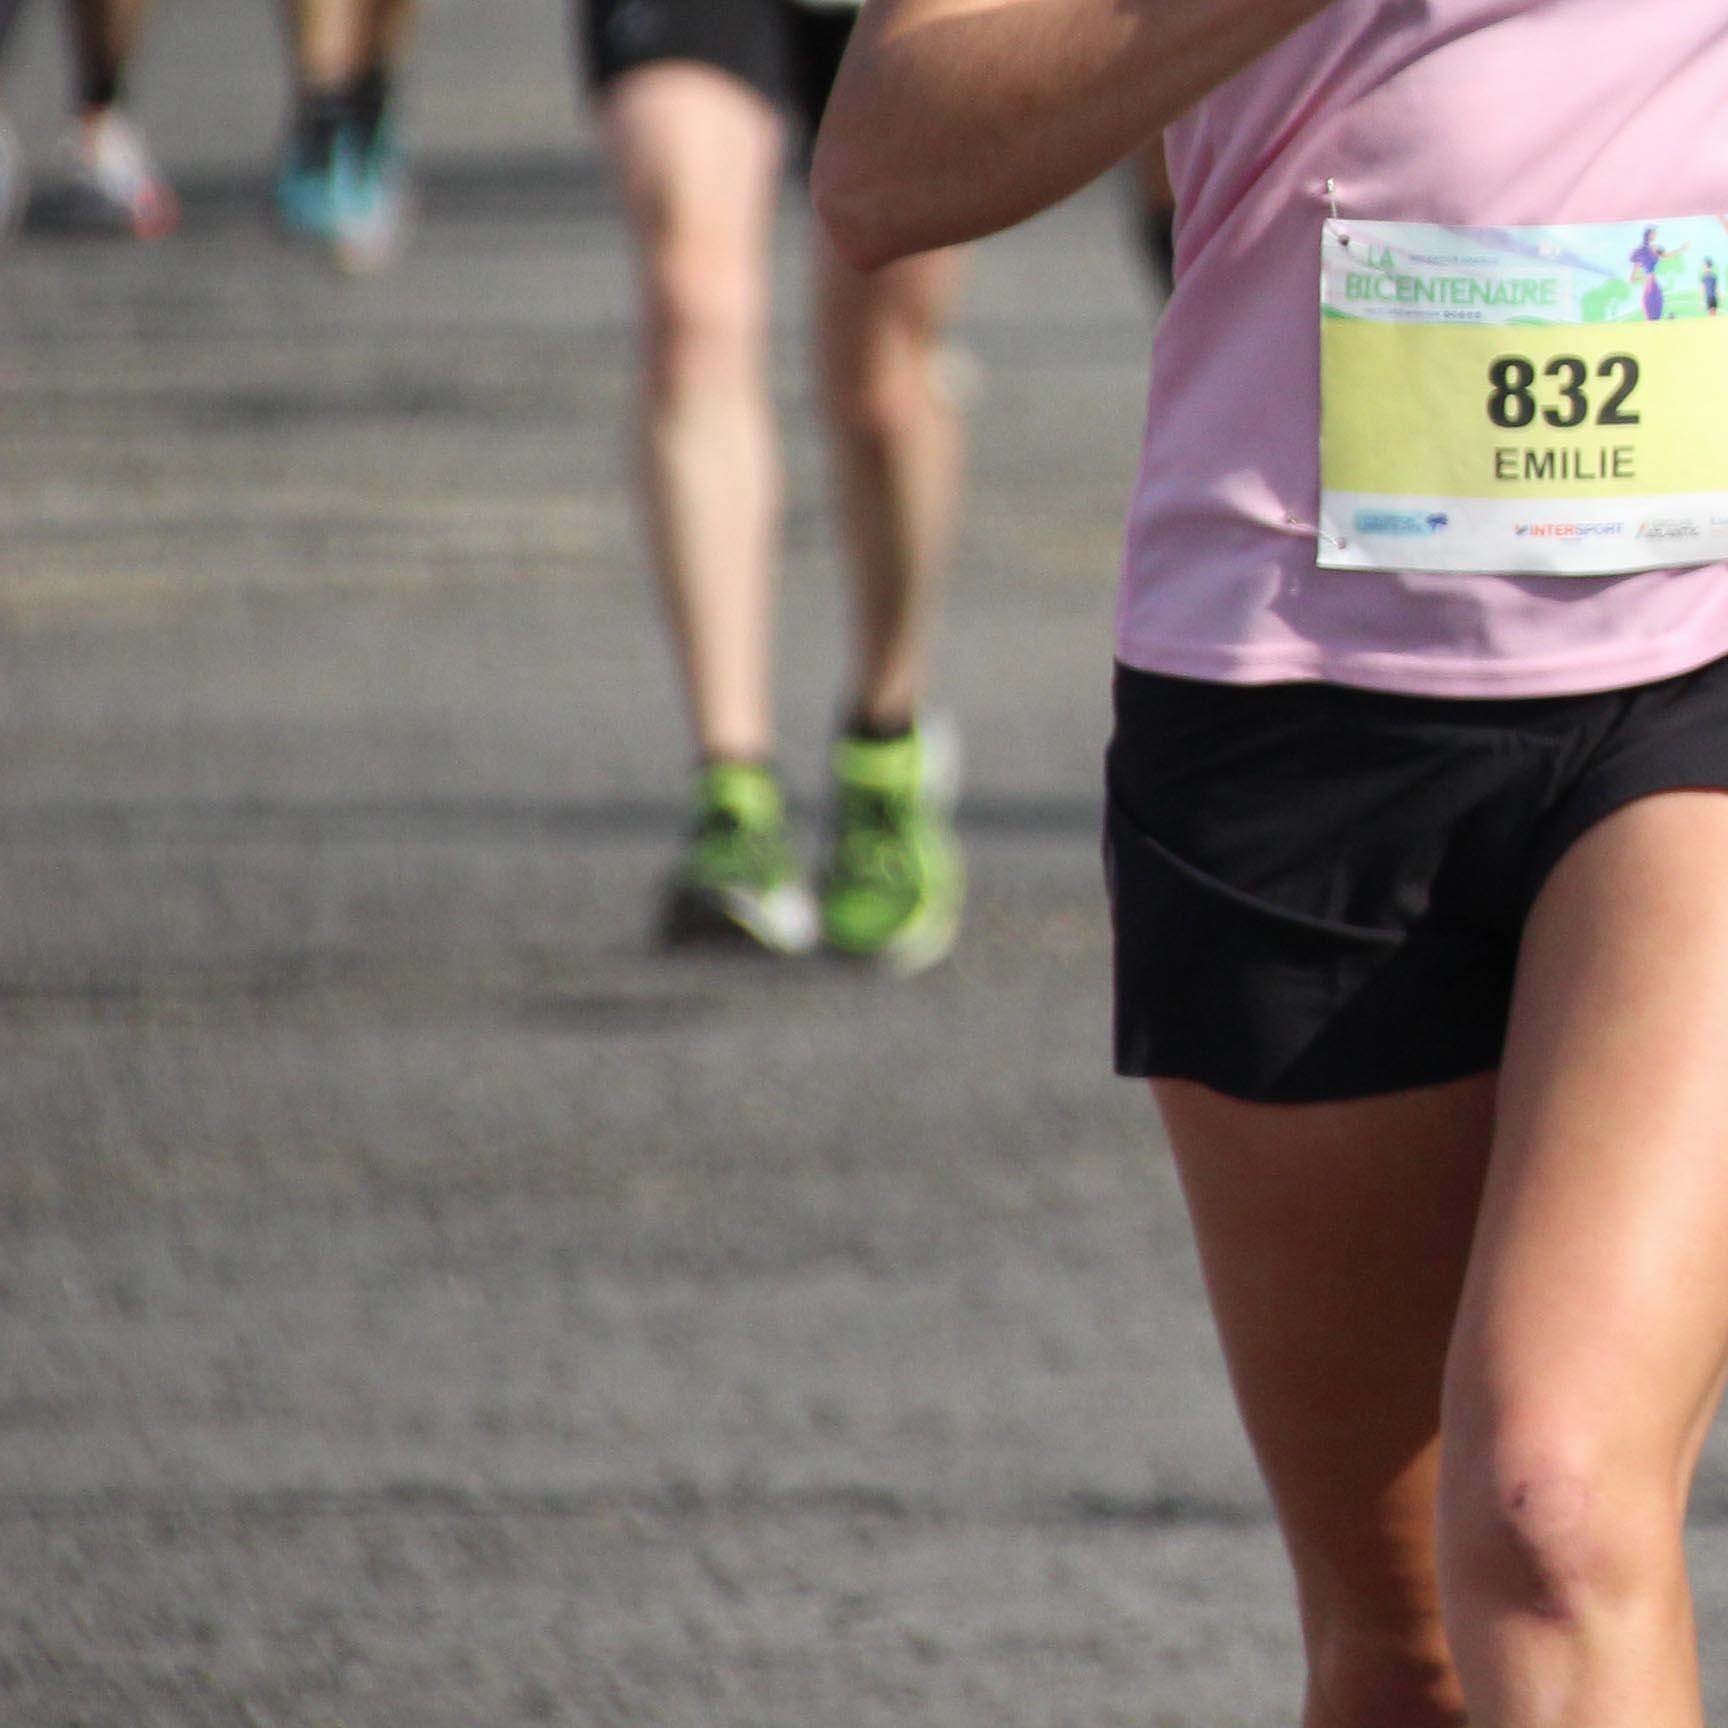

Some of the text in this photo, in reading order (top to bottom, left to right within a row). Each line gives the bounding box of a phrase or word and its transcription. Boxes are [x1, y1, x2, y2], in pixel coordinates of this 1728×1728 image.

[1344, 273, 1561, 306] BICENTENAIRE
[1487, 354, 1641, 429] 832
[1494, 446, 1637, 482] EMILIE
[1530, 521, 1624, 538] INTERSPORT
